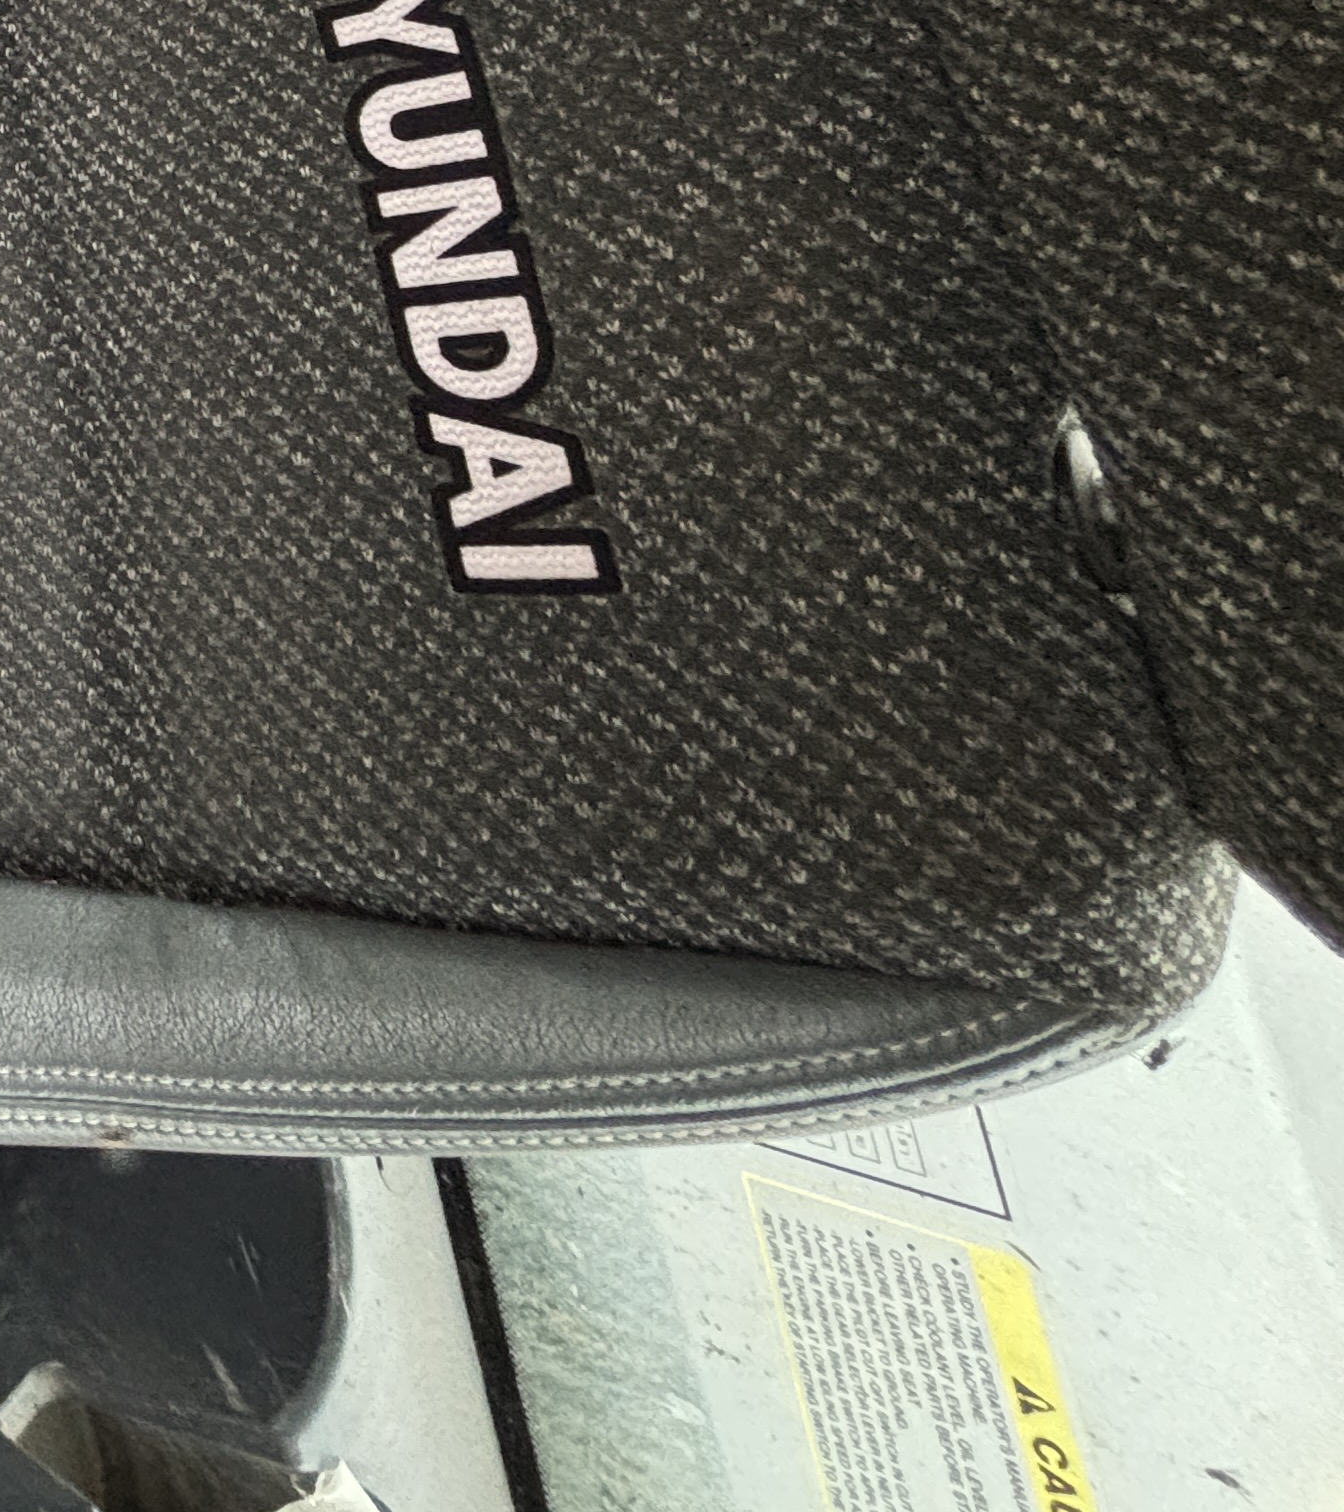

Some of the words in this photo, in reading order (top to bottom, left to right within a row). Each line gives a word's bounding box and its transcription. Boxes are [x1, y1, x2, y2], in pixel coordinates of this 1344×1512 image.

[774, 1266, 790, 1291] THE
[785, 1248, 802, 1273] THE
[804, 1261, 822, 1287] THE
[791, 1274, 814, 1323] ENGINE
[825, 1274, 841, 1300] THE
[841, 1280, 860, 1306] THE
[931, 1262, 967, 1349] OPERATING
[786, 1319, 803, 1341] OF
[812, 1287, 836, 1347] PARKING
[830, 1301, 852, 1339] GEAR
[849, 1307, 871, 1348] PILOT
[861, 1290, 887, 1347] BUCKET
[876, 1347, 893, 1367] TO
[865, 1240, 894, 1301] BEFORE
[881, 1302, 911, 1366] LEAVING
[898, 1367, 922, 1409] SEAT
[907, 1254, 932, 1307] CHECK
[921, 1309, 954, 1383] COOLANT
[950, 1268, 977, 1322] STUDY
[966, 1323, 988, 1354] THE
[804, 1324, 820, 1344] AT
[792, 1340, 819, 1406] STARTING
[808, 1344, 827, 1377] LOW
[826, 1348, 849, 1394] BRAKE
[841, 1341, 870, 1411] SELECTOR
[887, 1248, 913, 1300] OTHER
[903, 1301, 932, 1370] RELATED
[921, 1371, 947, 1423] PARTS
[934, 1424, 964, 1488] BEFORE
[817, 1377, 840, 1422] IDLING
[809, 1407, 832, 1462] SWITCH
[838, 1396, 862, 1450] SWITCH
[858, 1412, 881, 1457] LEVER
[875, 1409, 899, 1464] SWITCH
[829, 1424, 852, 1470] SPEED
[853, 1452, 869, 1472] TO
[822, 1462, 838, 1483] TO
[842, 1470, 860, 1501] FOR
